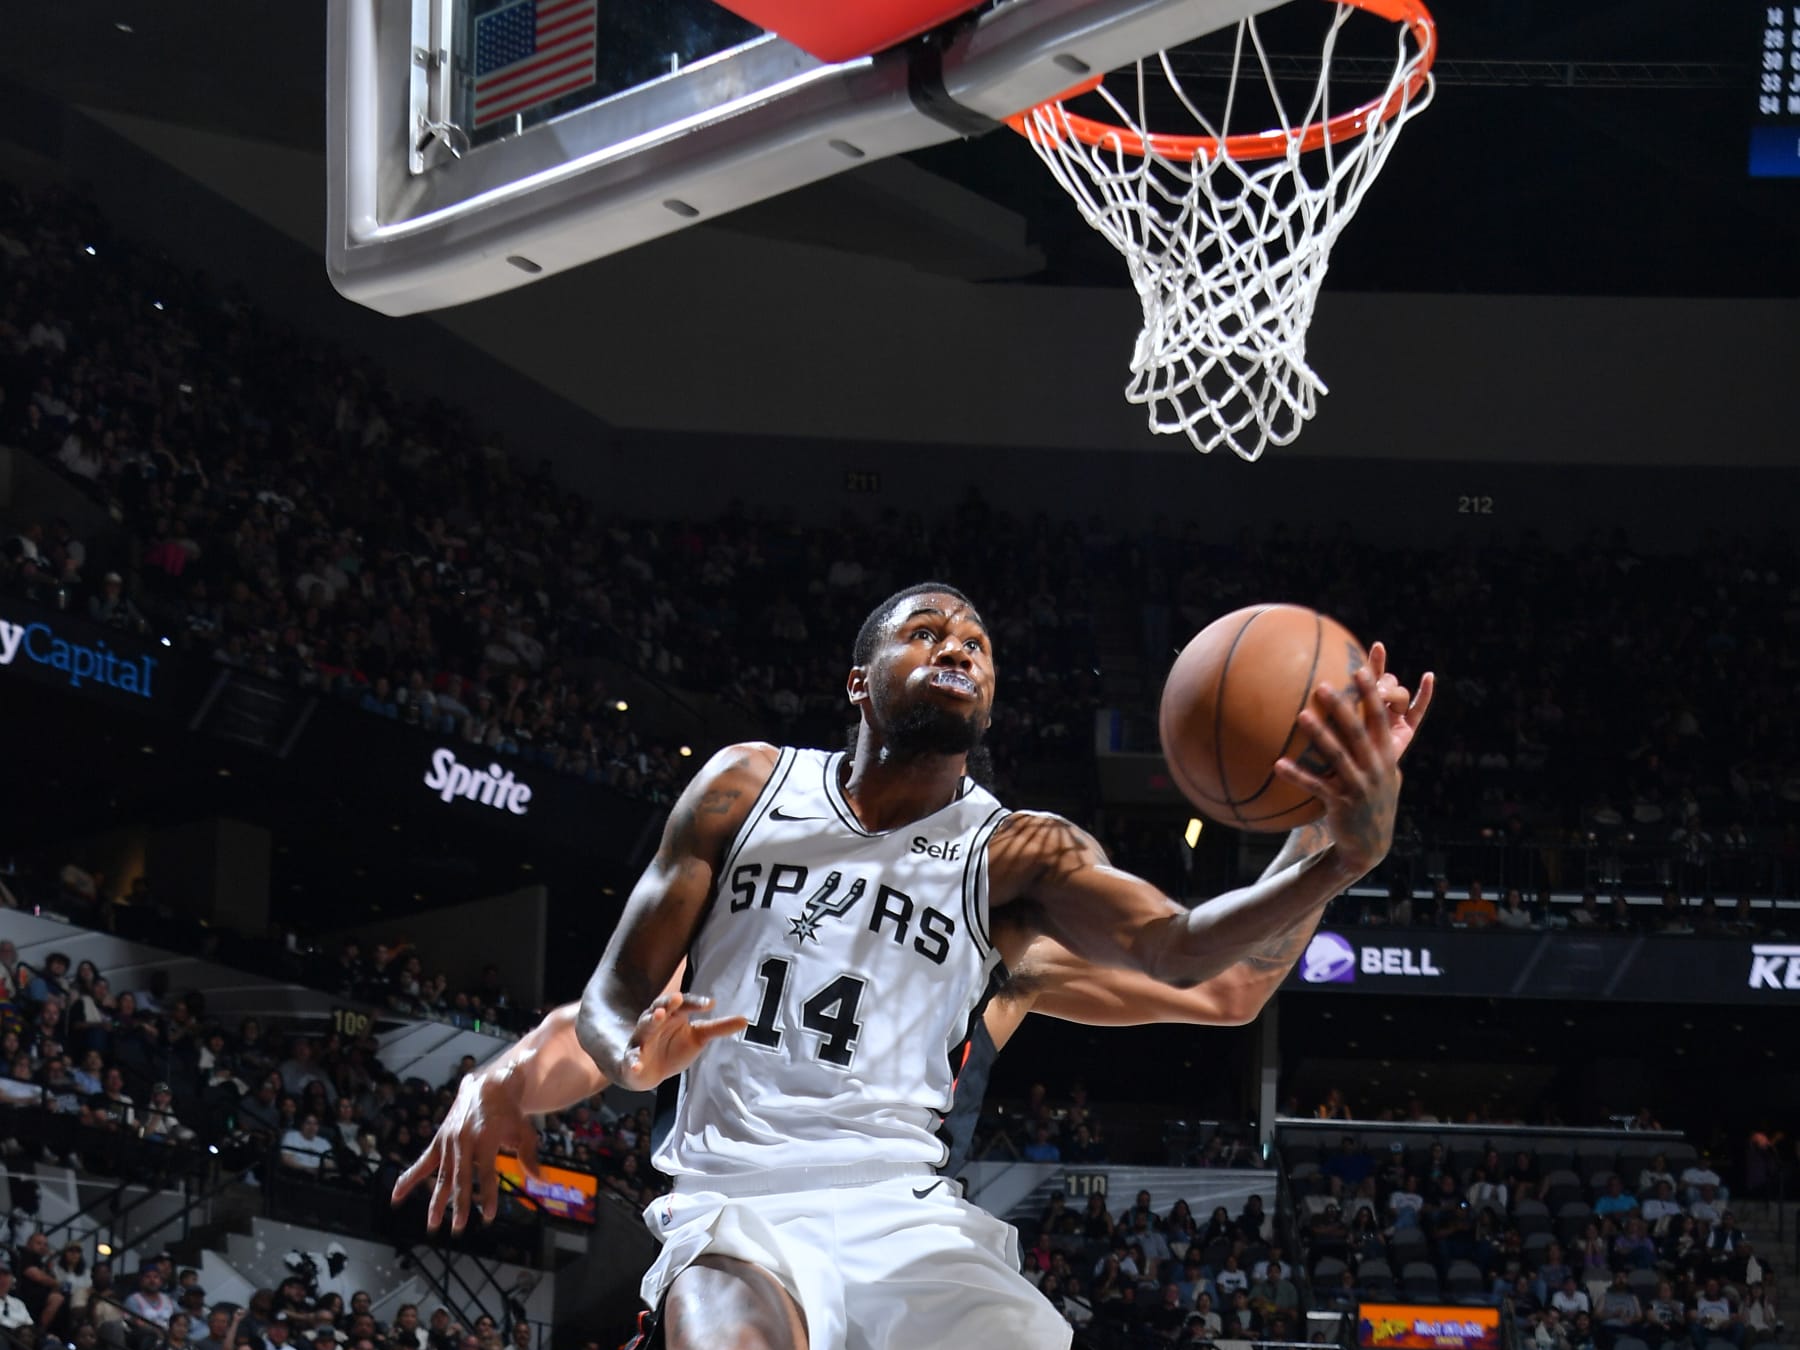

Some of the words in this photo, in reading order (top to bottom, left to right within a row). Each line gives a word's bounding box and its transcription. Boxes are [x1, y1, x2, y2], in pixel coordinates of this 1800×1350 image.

[1458, 496, 1493, 514] 212
[424, 747, 532, 815] Sprite
[730, 863, 956, 966] SPURS
[1361, 946, 1440, 976] BELL
[742, 956, 868, 1070] 14
[1067, 1175, 1106, 1196] 110
